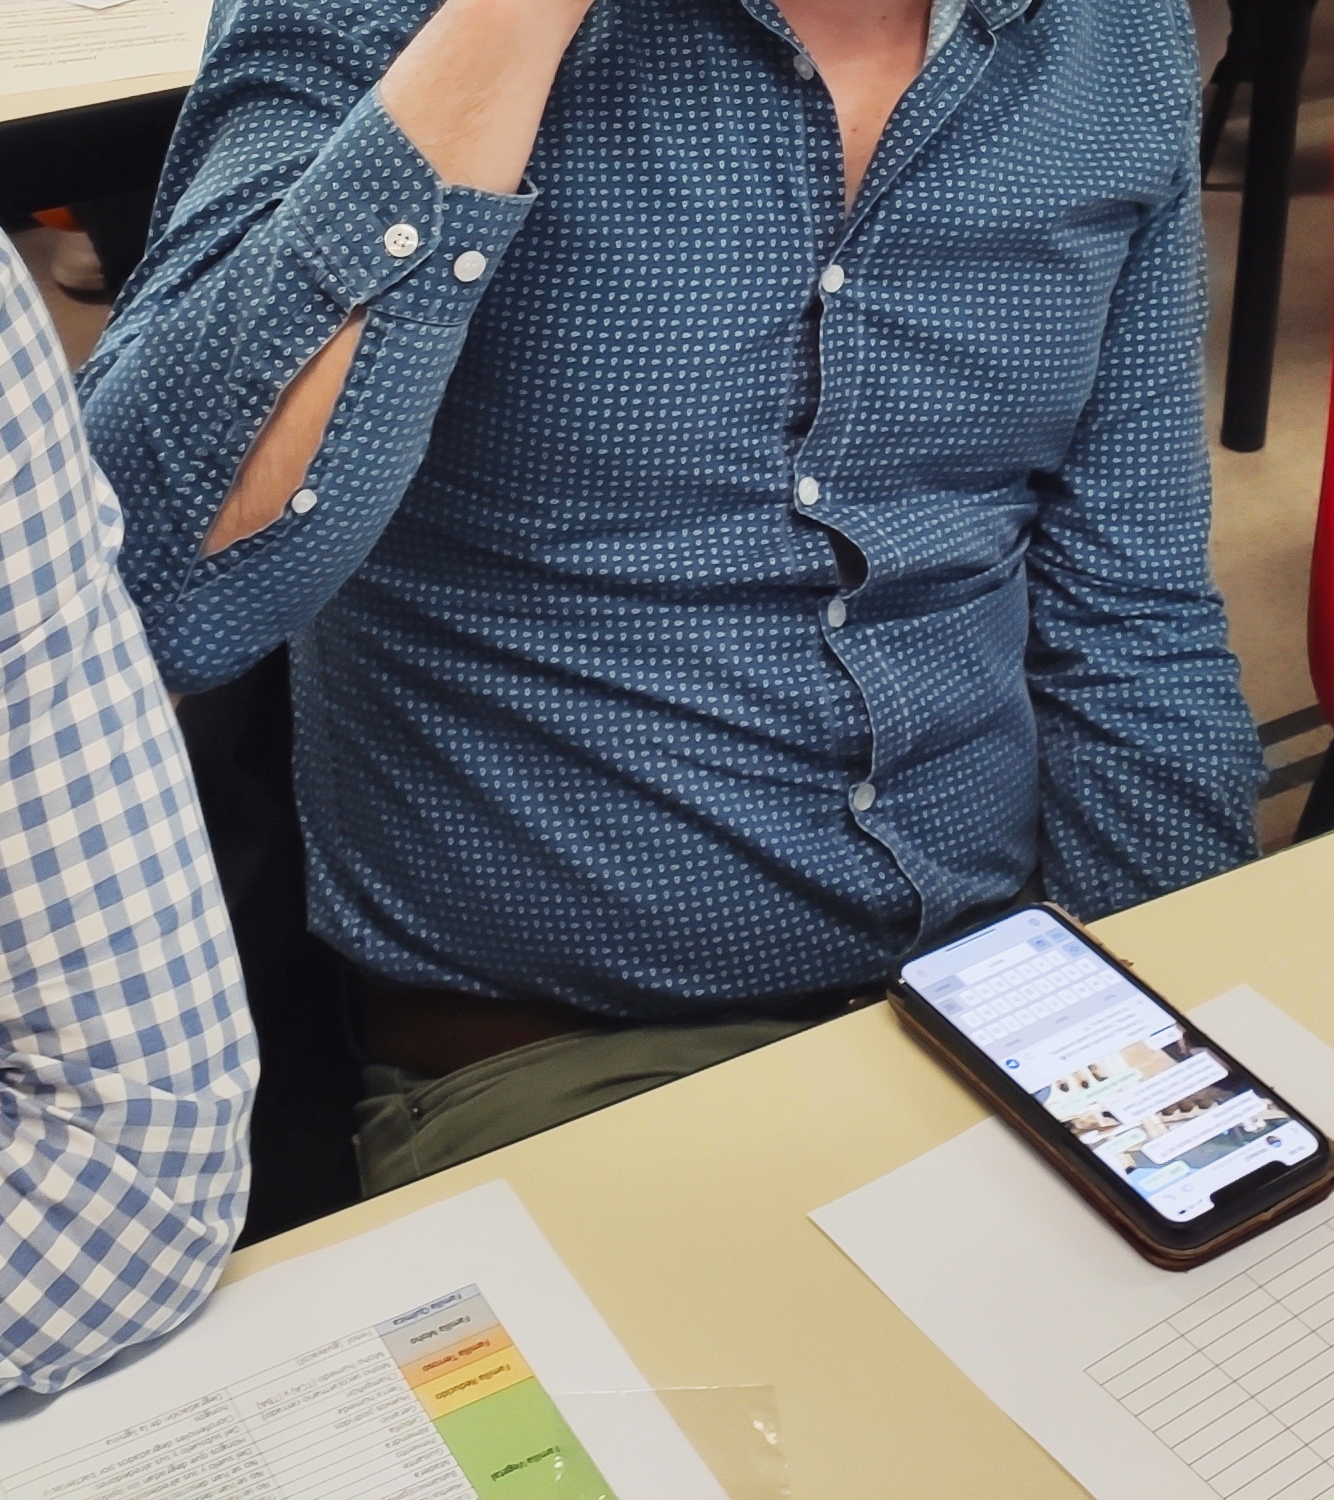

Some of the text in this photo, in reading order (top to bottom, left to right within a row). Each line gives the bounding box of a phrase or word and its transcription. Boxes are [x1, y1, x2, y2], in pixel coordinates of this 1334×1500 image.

[391, 1292, 463, 1326] Familia Química
[409, 1315, 471, 1345] Familia Moho
[421, 1339, 491, 1372] Familia Terroso
[434, 1363, 512, 1400] Familia Reducido
[490, 1460, 527, 1482] Vegetal
